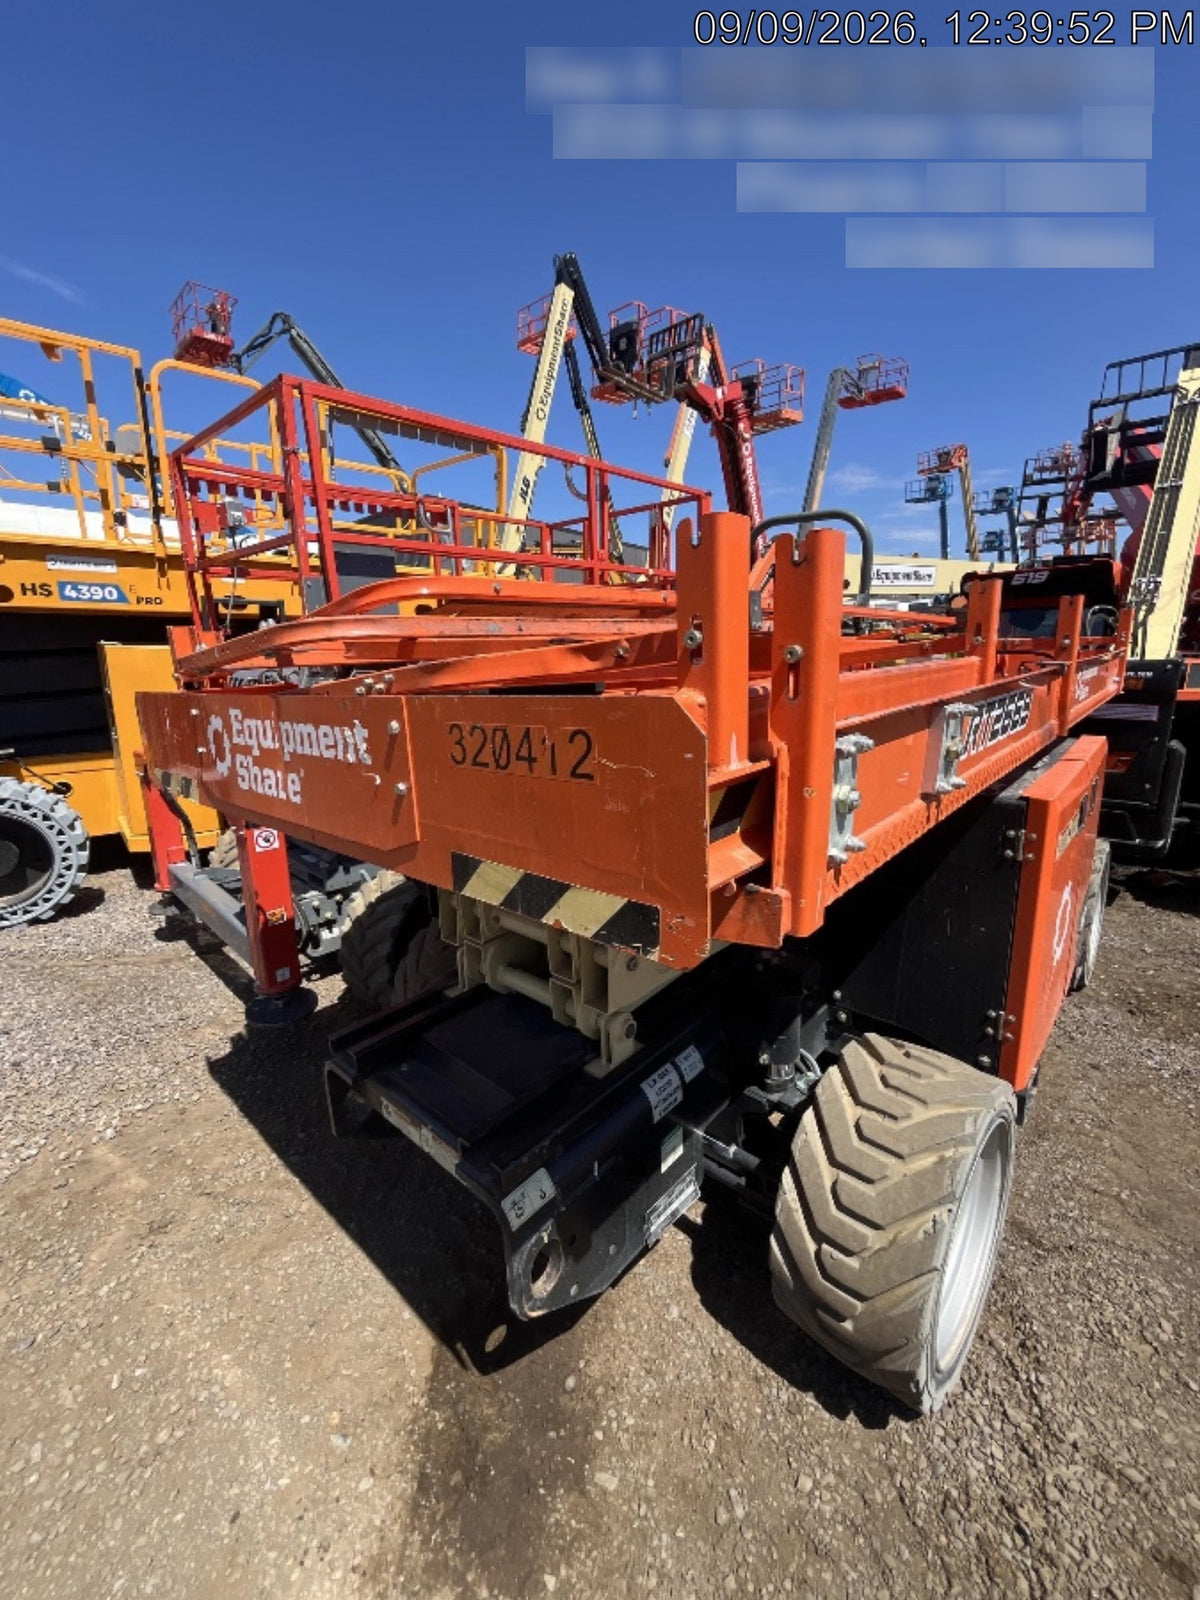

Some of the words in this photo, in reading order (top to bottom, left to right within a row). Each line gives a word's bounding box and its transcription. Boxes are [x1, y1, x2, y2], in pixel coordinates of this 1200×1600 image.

[20, 582, 53, 598] HS
[63, 584, 118, 601] 4390
[136, 596, 163, 605] PRO
[449, 723, 594, 782] 320412
